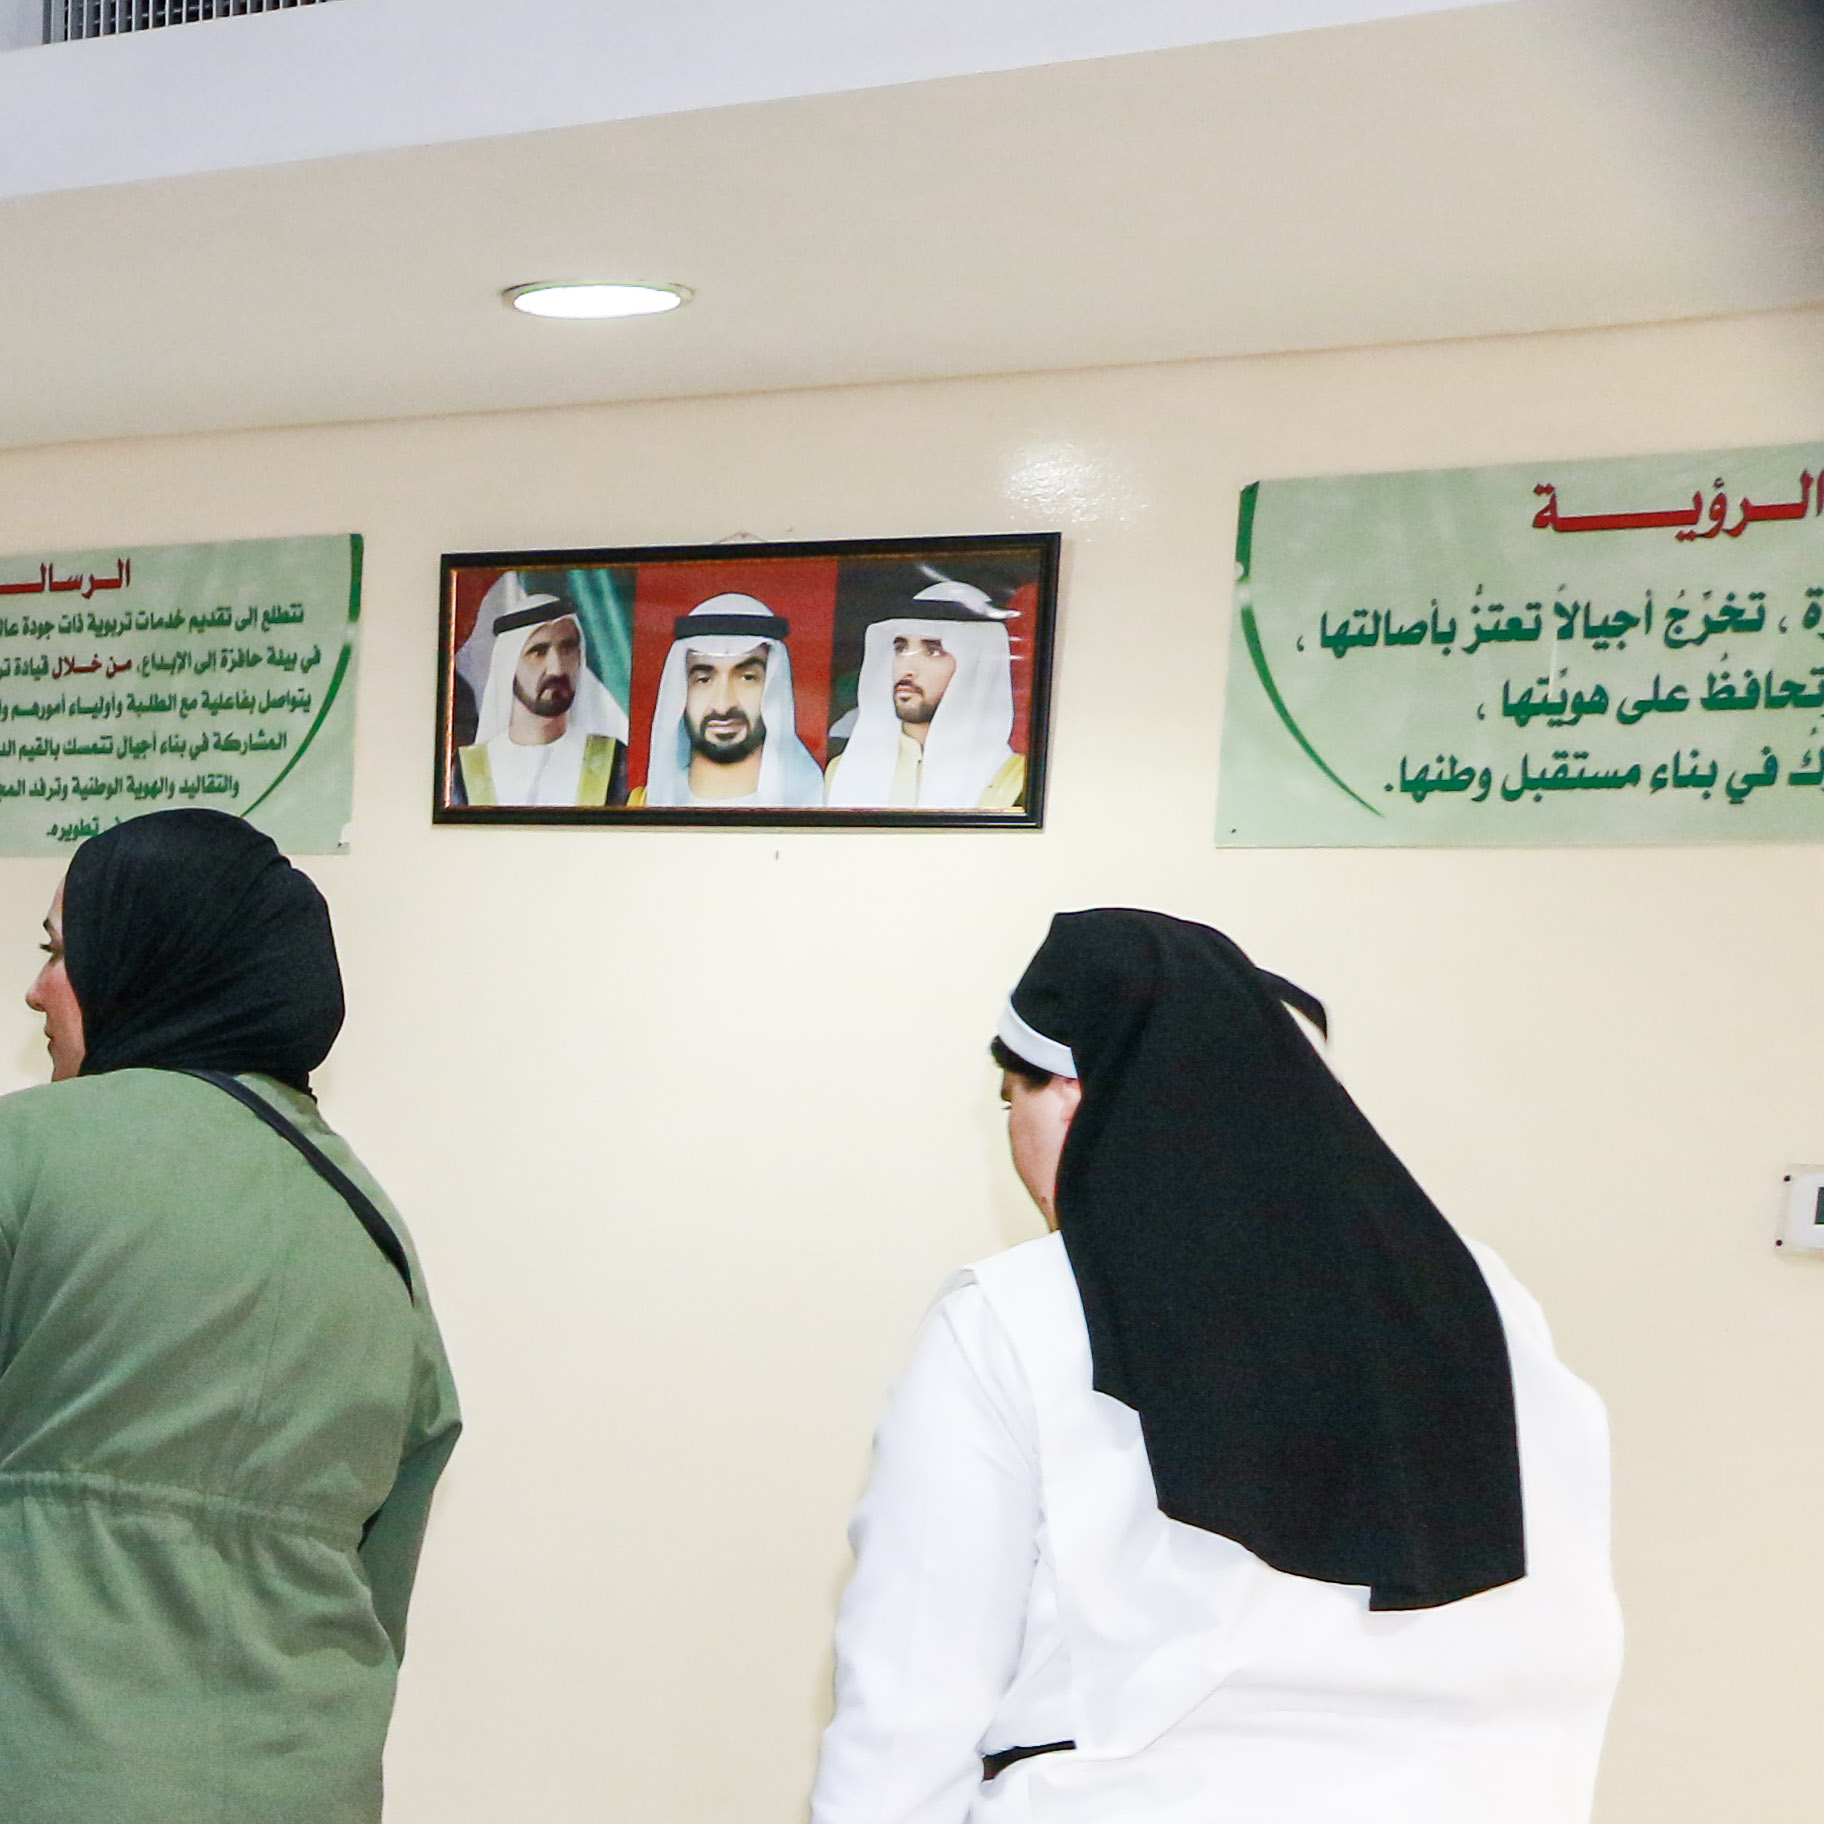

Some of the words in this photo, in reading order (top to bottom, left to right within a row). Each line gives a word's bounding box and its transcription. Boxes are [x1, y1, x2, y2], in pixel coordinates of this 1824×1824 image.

[22, 616, 54, 640] جودة
[58, 614, 84, 633] ذات
[87, 611, 132, 637] تربوية
[136, 608, 185, 630] خدمات
[189, 606, 232, 633] تقديم
[14, 654, 49, 681] قيادة
[53, 653, 102, 679] خلال
[106, 656, 132, 678] من
[221, 647, 263, 672] حافزة
[301, 644, 321, 673] في
[127, 693, 177, 717] الطلبة
[179, 695, 198, 719] مع
[201, 689, 256, 716] بفاعلية
[259, 688, 311, 713] يتواصل
[1617, 673, 1689, 725] على
[19, 736, 60, 761] بالقيم
[160, 733, 186, 759] بناء
[188, 731, 210, 760] في
[212, 728, 287, 755] المشاركة
[179, 773, 239, 799] والتقاليد
[1501, 750, 1641, 802] مستقبل
[1650, 748, 1718, 800] بناء
[1725, 746, 1779, 804] في
[72, 776, 123, 800] الوطنية
[127, 775, 175, 800] والهوية
